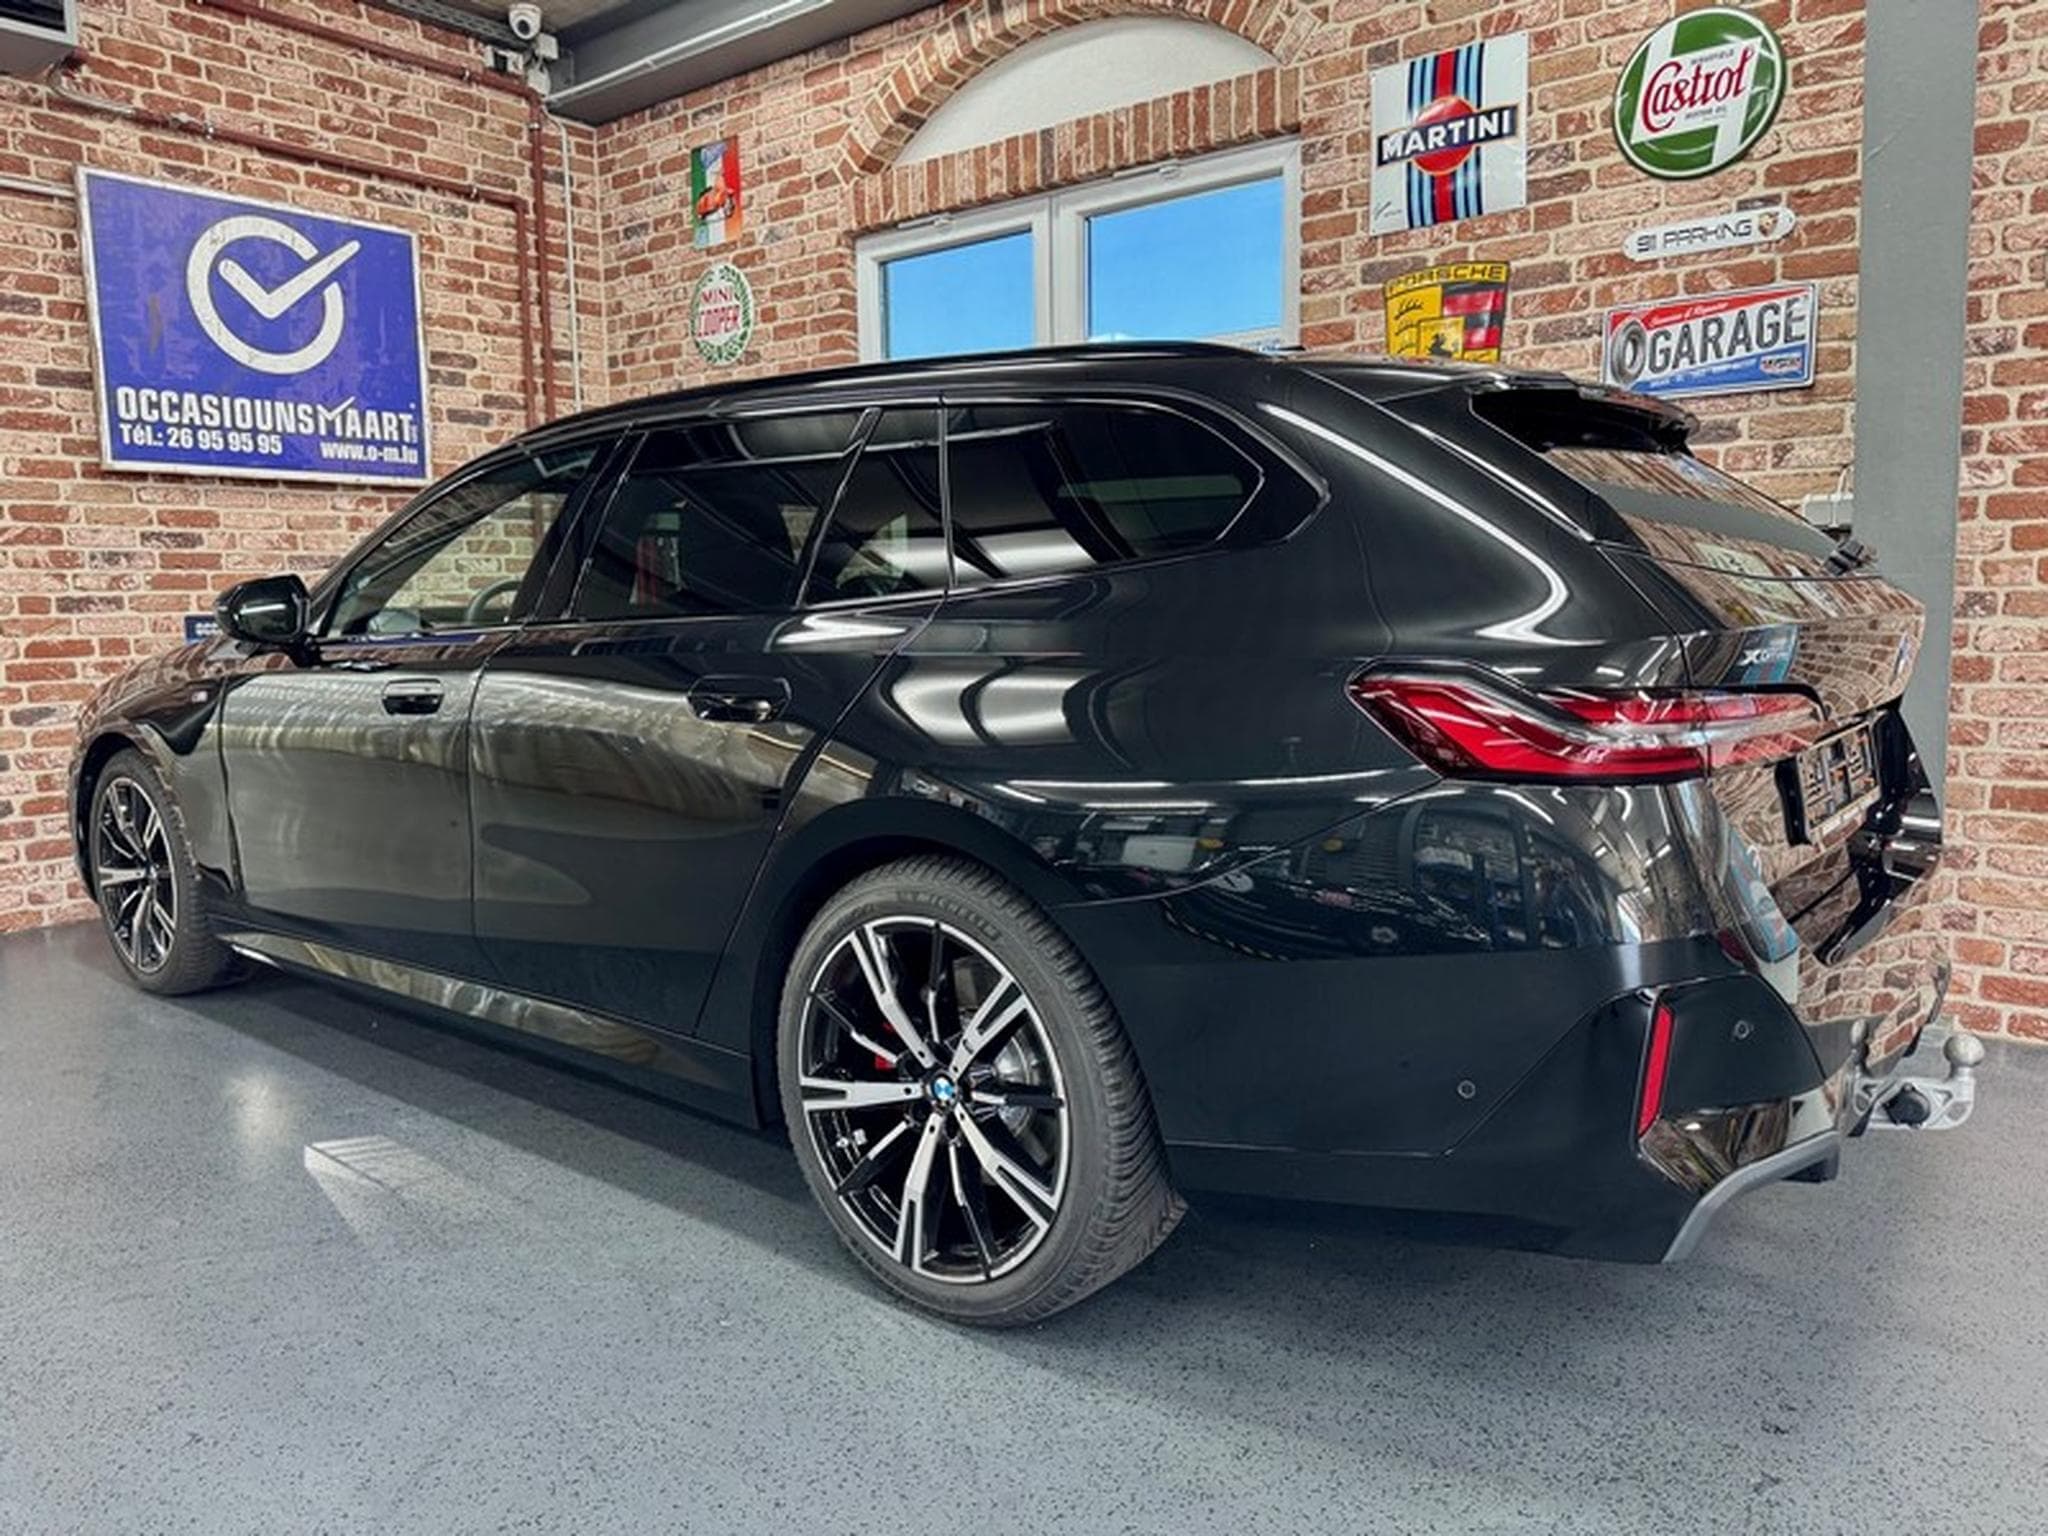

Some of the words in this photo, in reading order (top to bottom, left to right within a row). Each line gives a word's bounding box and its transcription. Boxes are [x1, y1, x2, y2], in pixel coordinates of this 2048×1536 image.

[1642, 46, 1754, 133] Castrol
[1381, 109, 1511, 160] MARTINI
[1662, 219, 1752, 248] PARKING
[1388, 265, 1503, 294] PORSCHE
[701, 287, 733, 303] MINI
[1650, 297, 1807, 374] GARAGE
[116, 386, 413, 442] OCCASIOUNSMAART
[167, 427, 193, 450] 26
[198, 430, 224, 451] 95
[228, 432, 254, 453] 95
[257, 434, 283, 455] 95
[320, 441, 418, 465] www.o-m.lu
